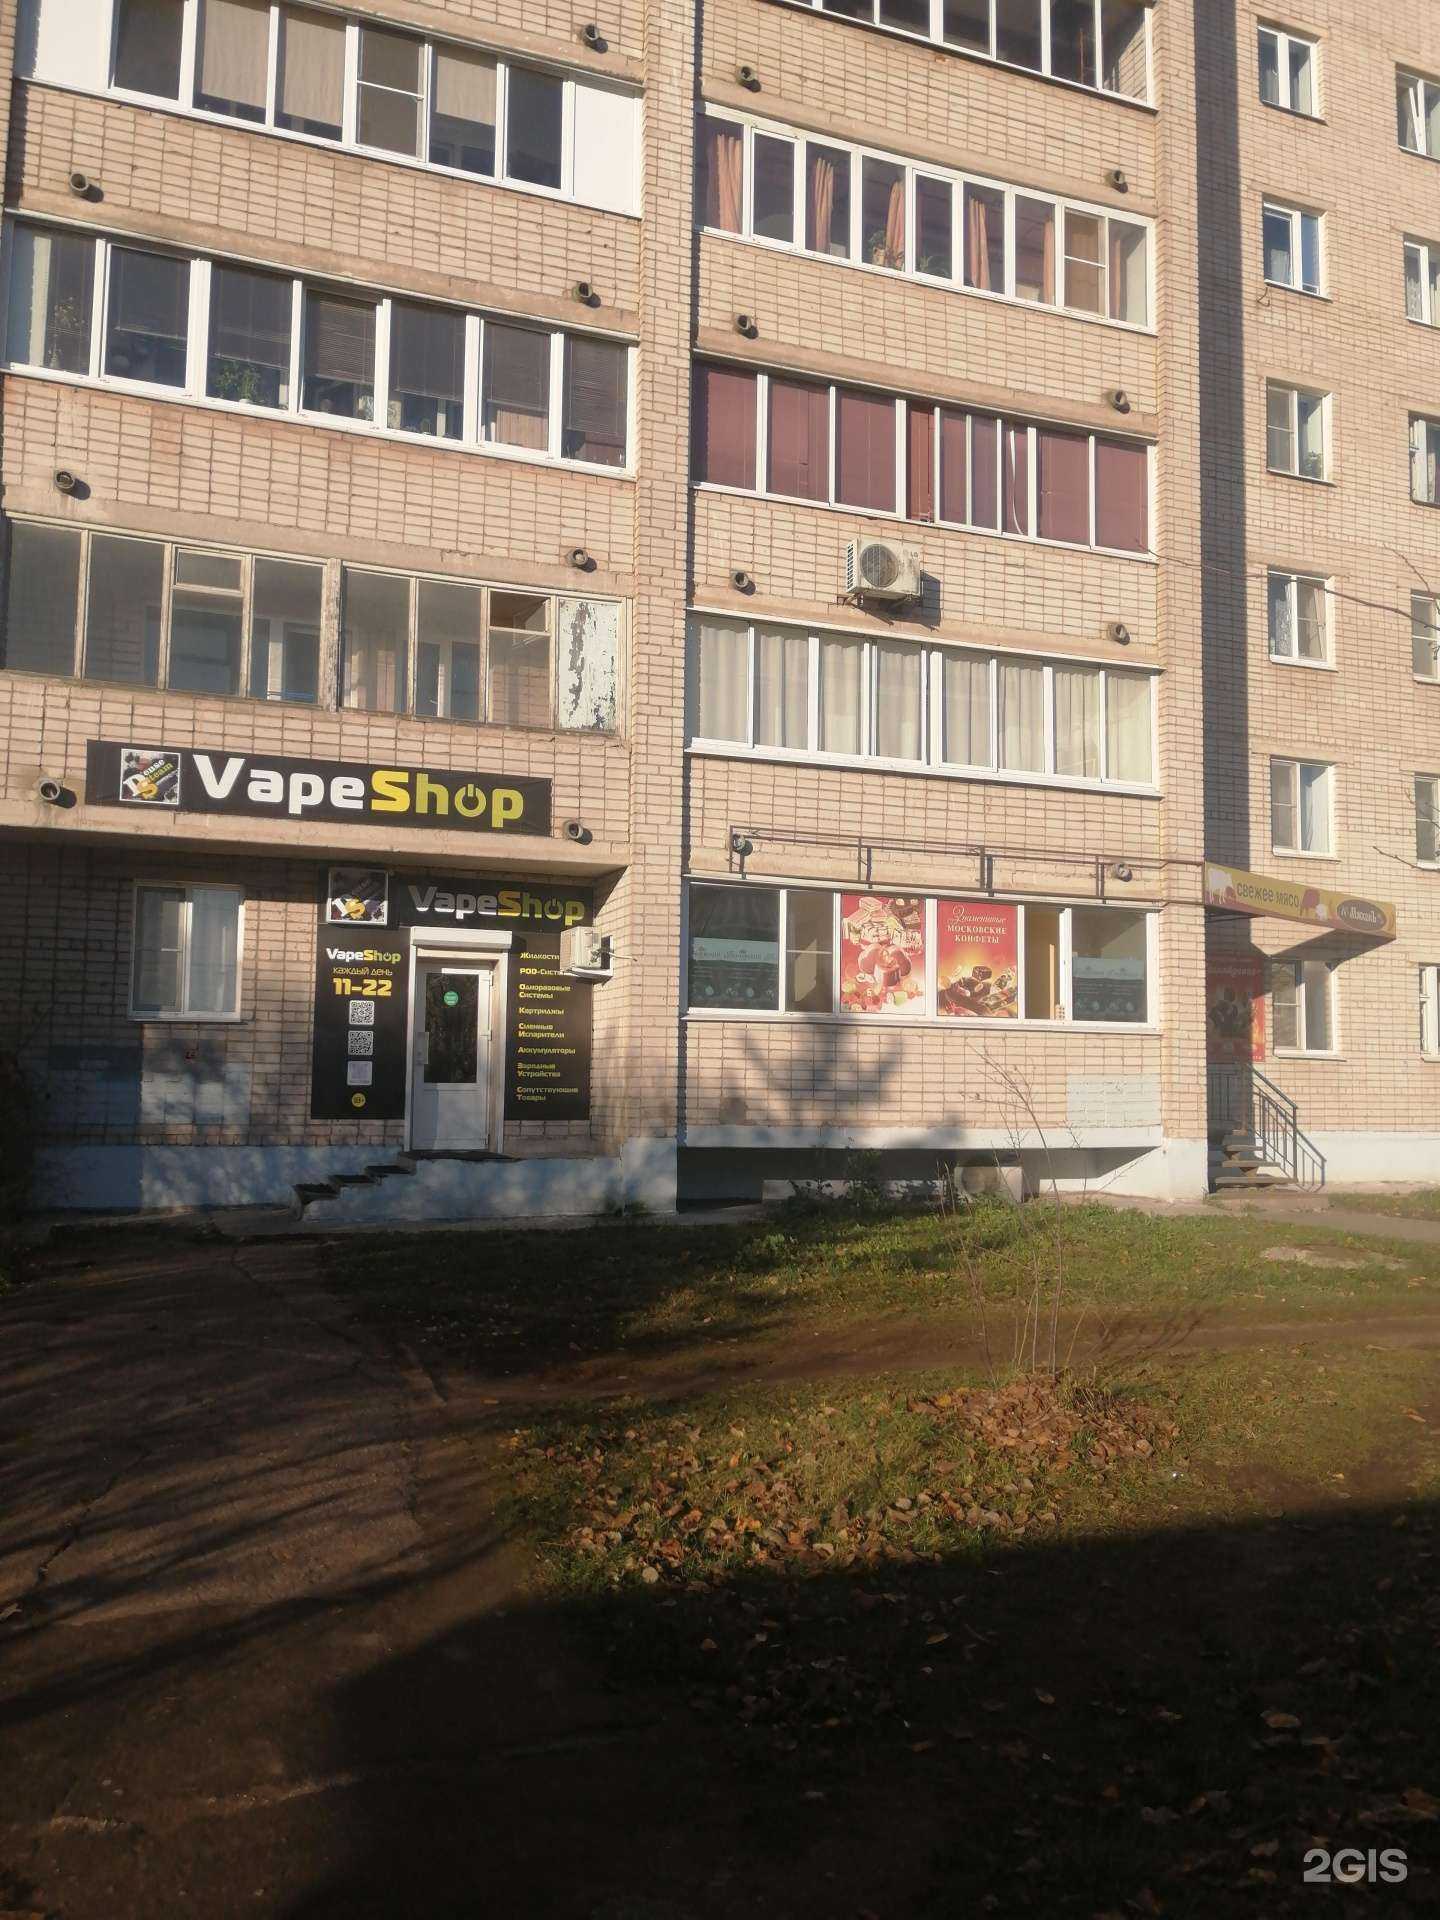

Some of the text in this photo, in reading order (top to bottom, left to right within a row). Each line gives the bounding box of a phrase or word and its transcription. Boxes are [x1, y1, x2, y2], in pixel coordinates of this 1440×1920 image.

[192, 754, 524, 828] VapeShop
[408, 885, 585, 926] VapeShop
[326, 948, 401, 964] VapeShop
[333, 978, 392, 996] 11-22
[519, 991, 553, 999] Системы
